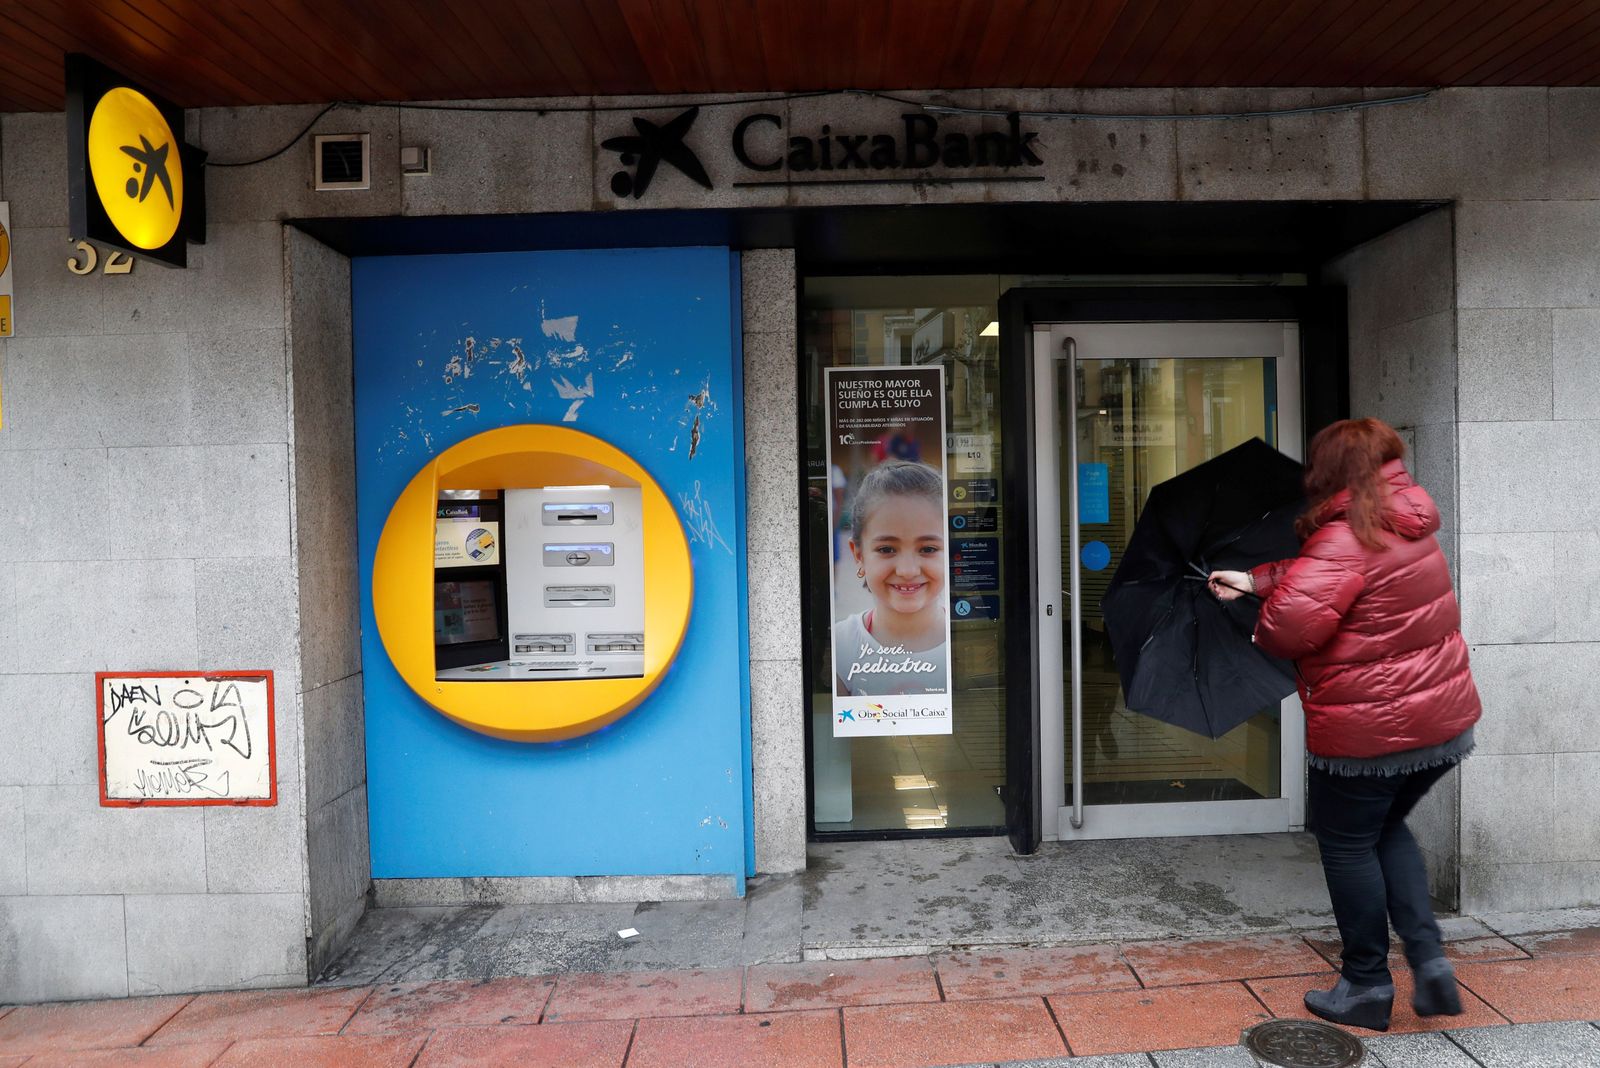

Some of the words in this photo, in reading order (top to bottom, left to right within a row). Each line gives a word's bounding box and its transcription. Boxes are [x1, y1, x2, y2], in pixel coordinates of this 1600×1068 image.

[732, 110, 1044, 172] CaixaBank
[838, 380, 882, 389] NUESTRO
[885, 379, 921, 388] MAYOR
[838, 388, 871, 399] SUEÑO
[874, 390, 885, 399] ES
[887, 389, 907, 399] QUE
[910, 389, 933, 398] ELLA
[838, 400, 879, 409] CUMPLA
[881, 400, 892, 408] EL
[894, 399, 921, 408] SUYO
[859, 642, 875, 659] Yo
[876, 644, 913, 655] seré...
[847, 656, 937, 681] pediatra
[882, 708, 908, 718] Social
